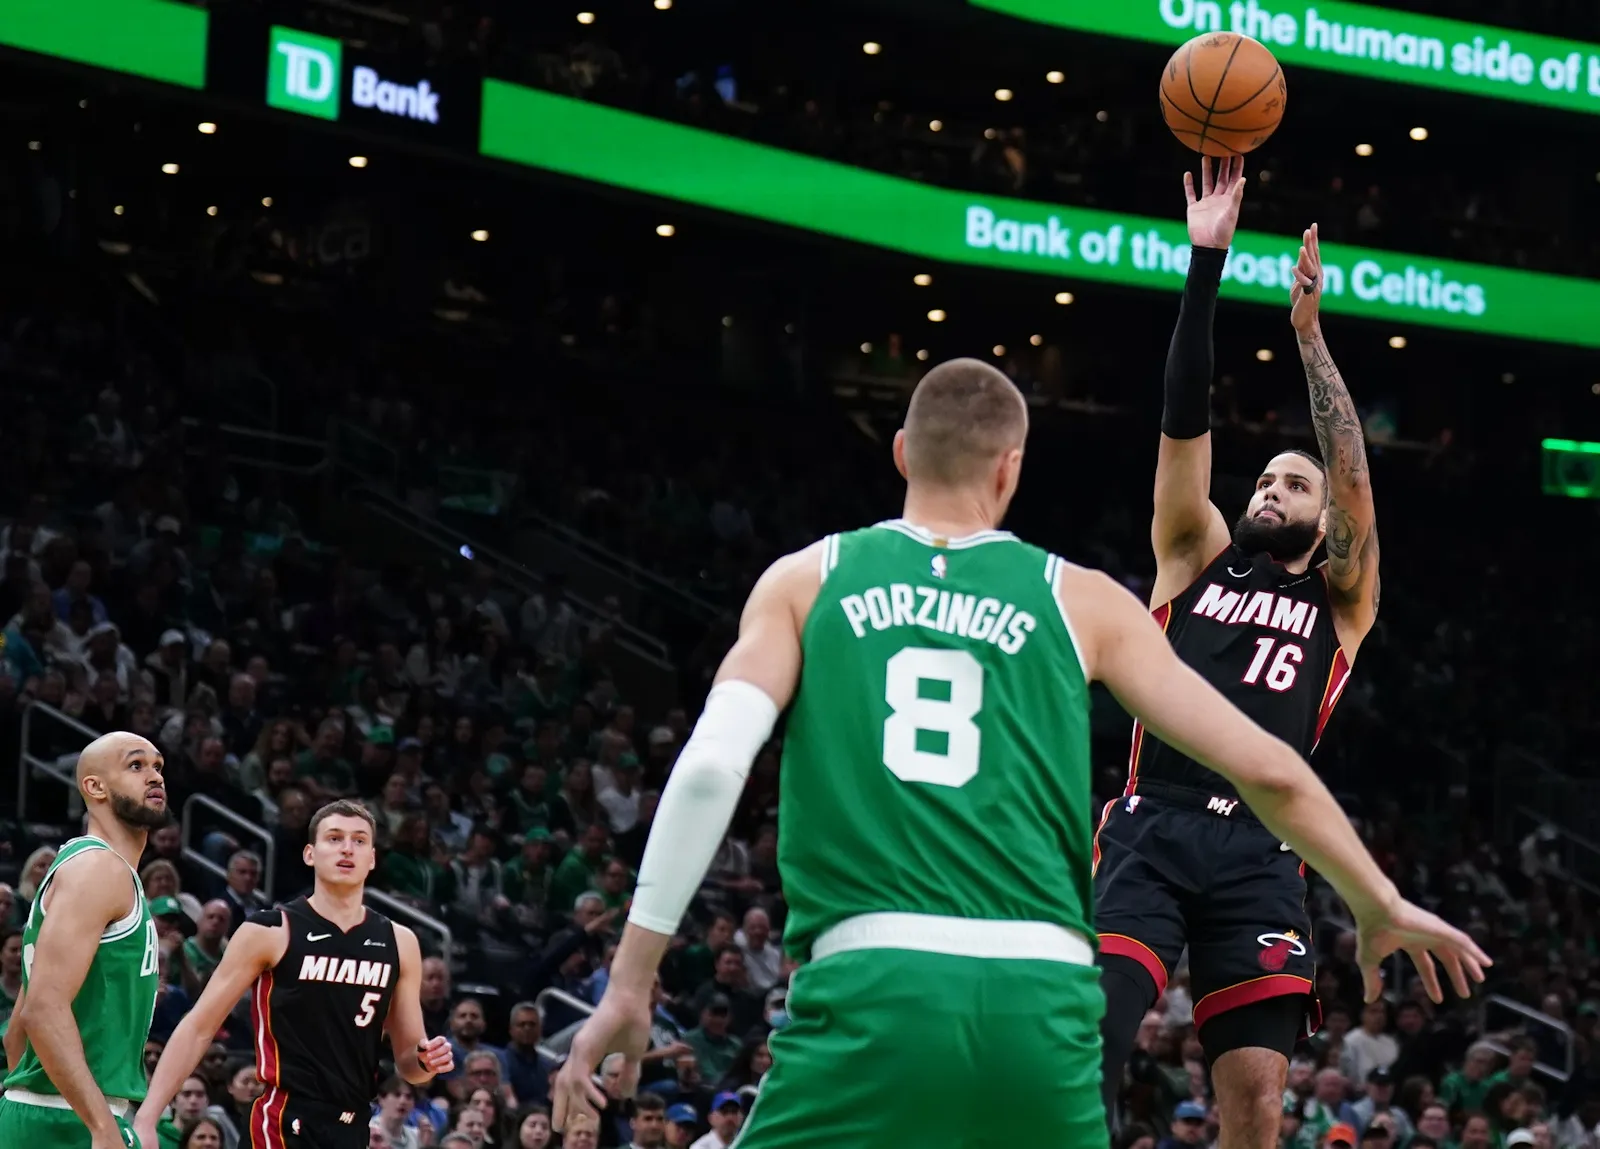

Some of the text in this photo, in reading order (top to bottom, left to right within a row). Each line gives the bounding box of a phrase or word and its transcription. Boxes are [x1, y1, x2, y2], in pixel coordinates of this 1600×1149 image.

[1159, 0, 1221, 31] On
[1229, 0, 1297, 46] the
[1305, 8, 1444, 71] human
[1451, 36, 1534, 86] side
[1540, 52, 1582, 93] of
[276, 41, 439, 125] TD Bank
[966, 205, 1486, 317] Bank of the ostn Celtics
[840, 583, 1036, 655] PORZINGIS
[1191, 582, 1319, 640] MIAMI
[1241, 636, 1304, 693] 16
[883, 647, 983, 788] 8
[298, 954, 392, 989] MIAMI
[353, 991, 382, 1028] 5
